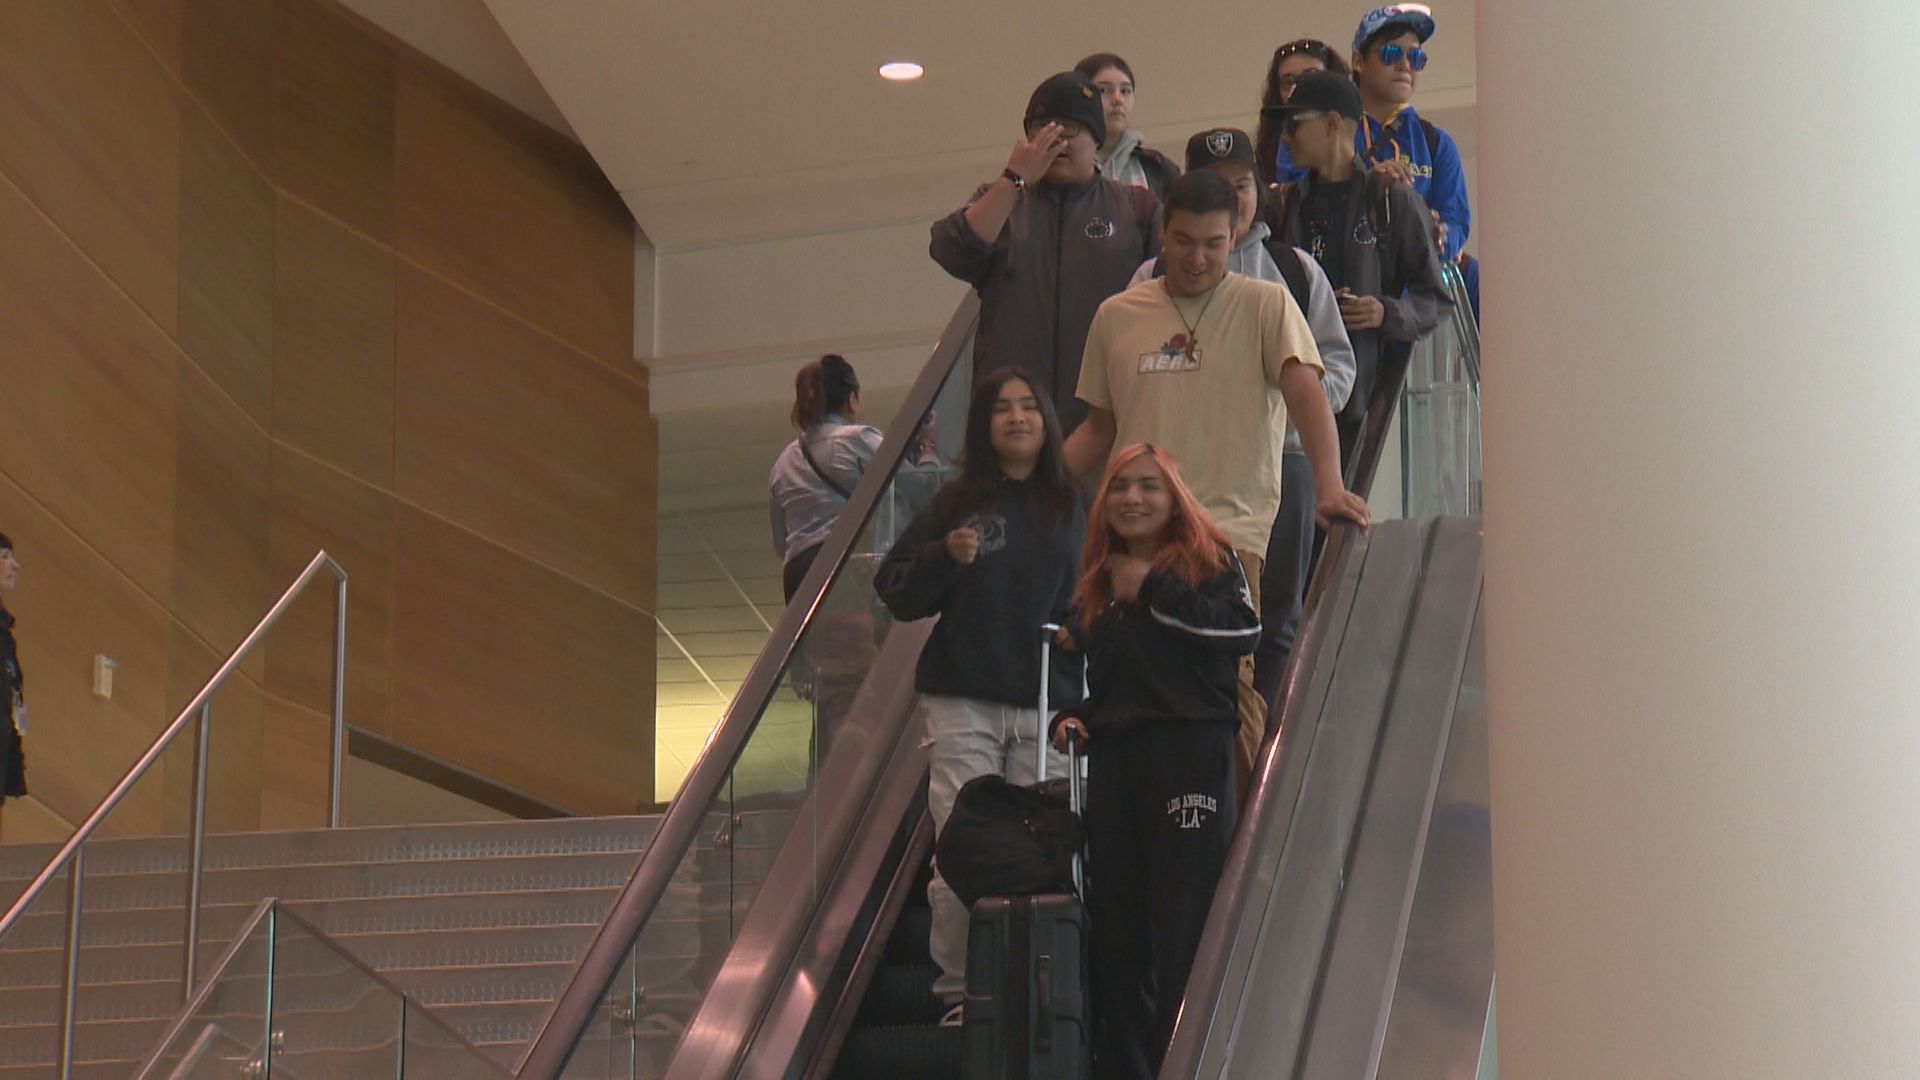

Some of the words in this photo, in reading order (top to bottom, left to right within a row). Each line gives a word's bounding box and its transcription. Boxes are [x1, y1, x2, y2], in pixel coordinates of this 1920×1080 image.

[1167, 797, 1180, 814] LOS
[1182, 793, 1217, 812] ANGELES
[1180, 808, 1201, 829] LA
